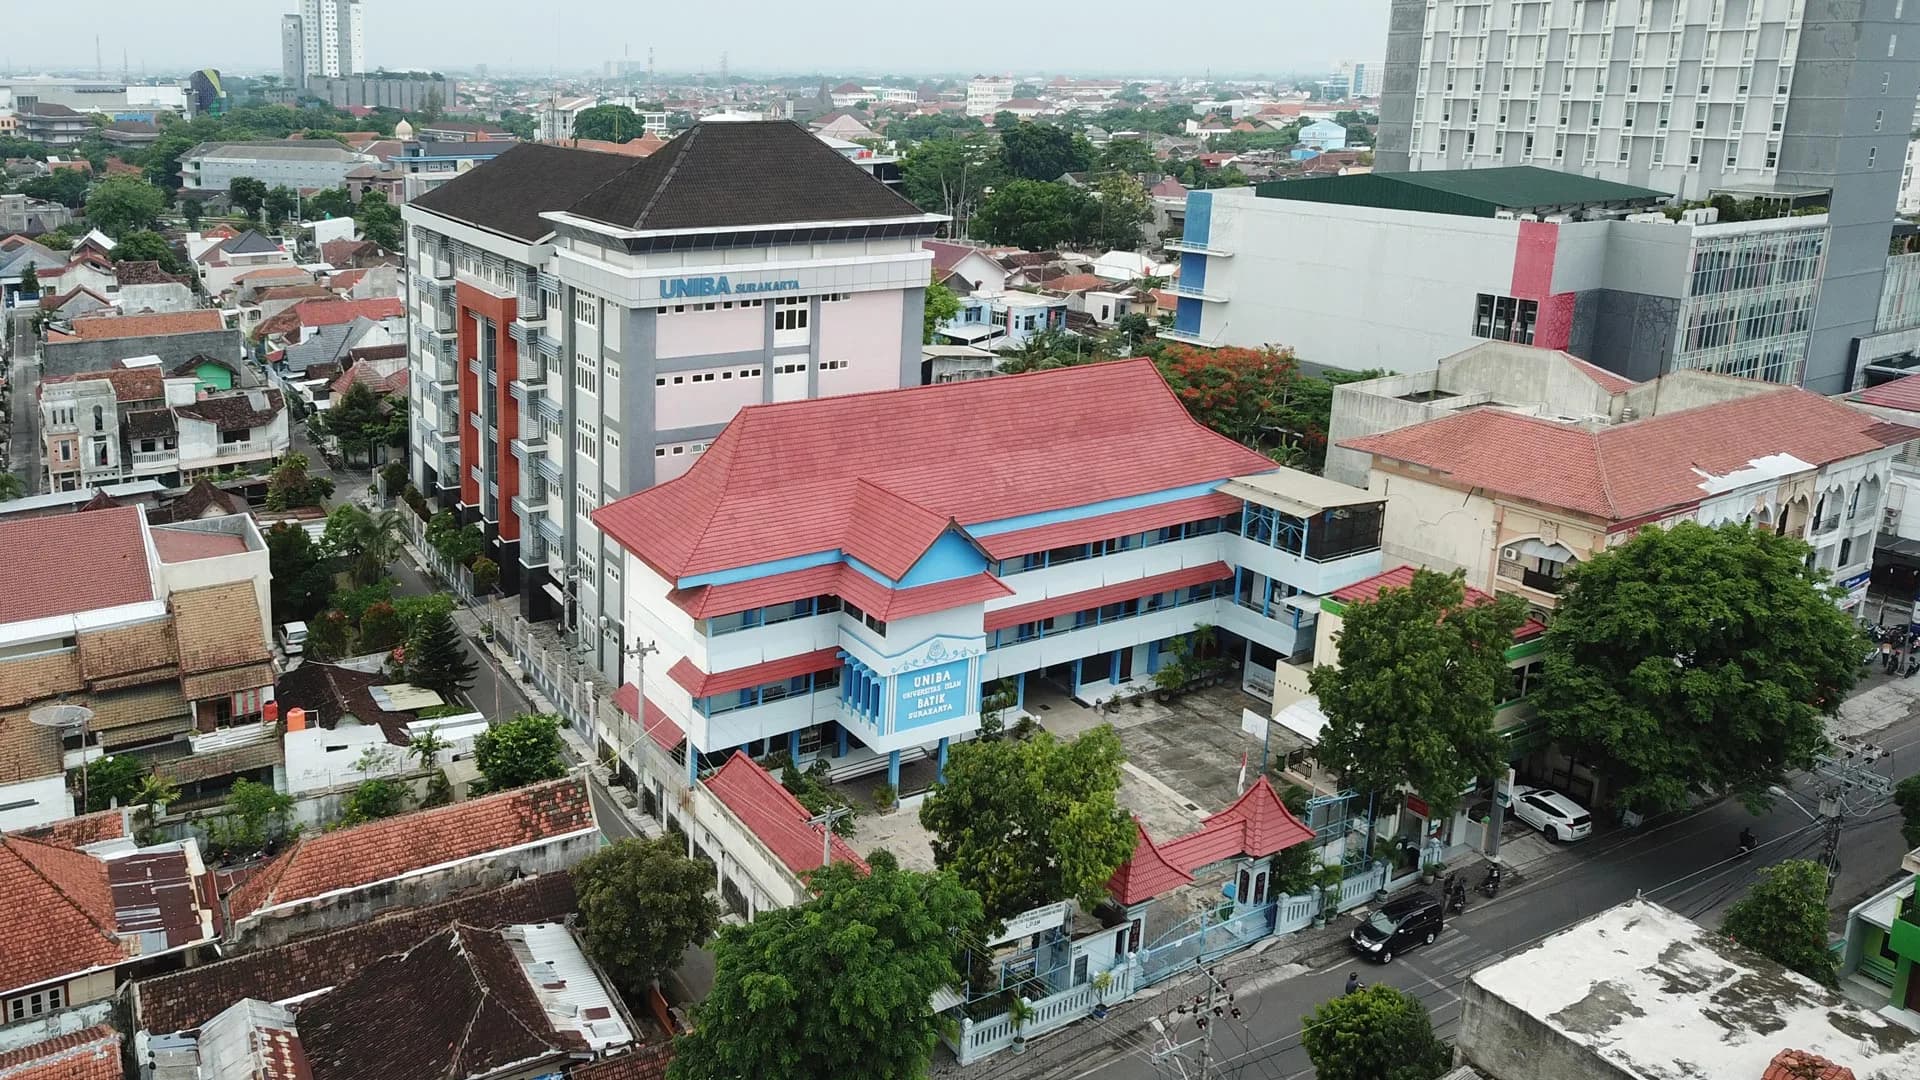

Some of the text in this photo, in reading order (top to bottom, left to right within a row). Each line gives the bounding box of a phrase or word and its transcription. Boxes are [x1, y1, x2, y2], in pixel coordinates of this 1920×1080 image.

[660, 276, 800, 299] UNIBA SURAKARTA
[914, 670, 951, 687] UNIBA
[902, 685, 941, 699] UNIVERSITAS
[917, 693, 946, 709] BATIK
[907, 703, 953, 719] SURAKARTA
